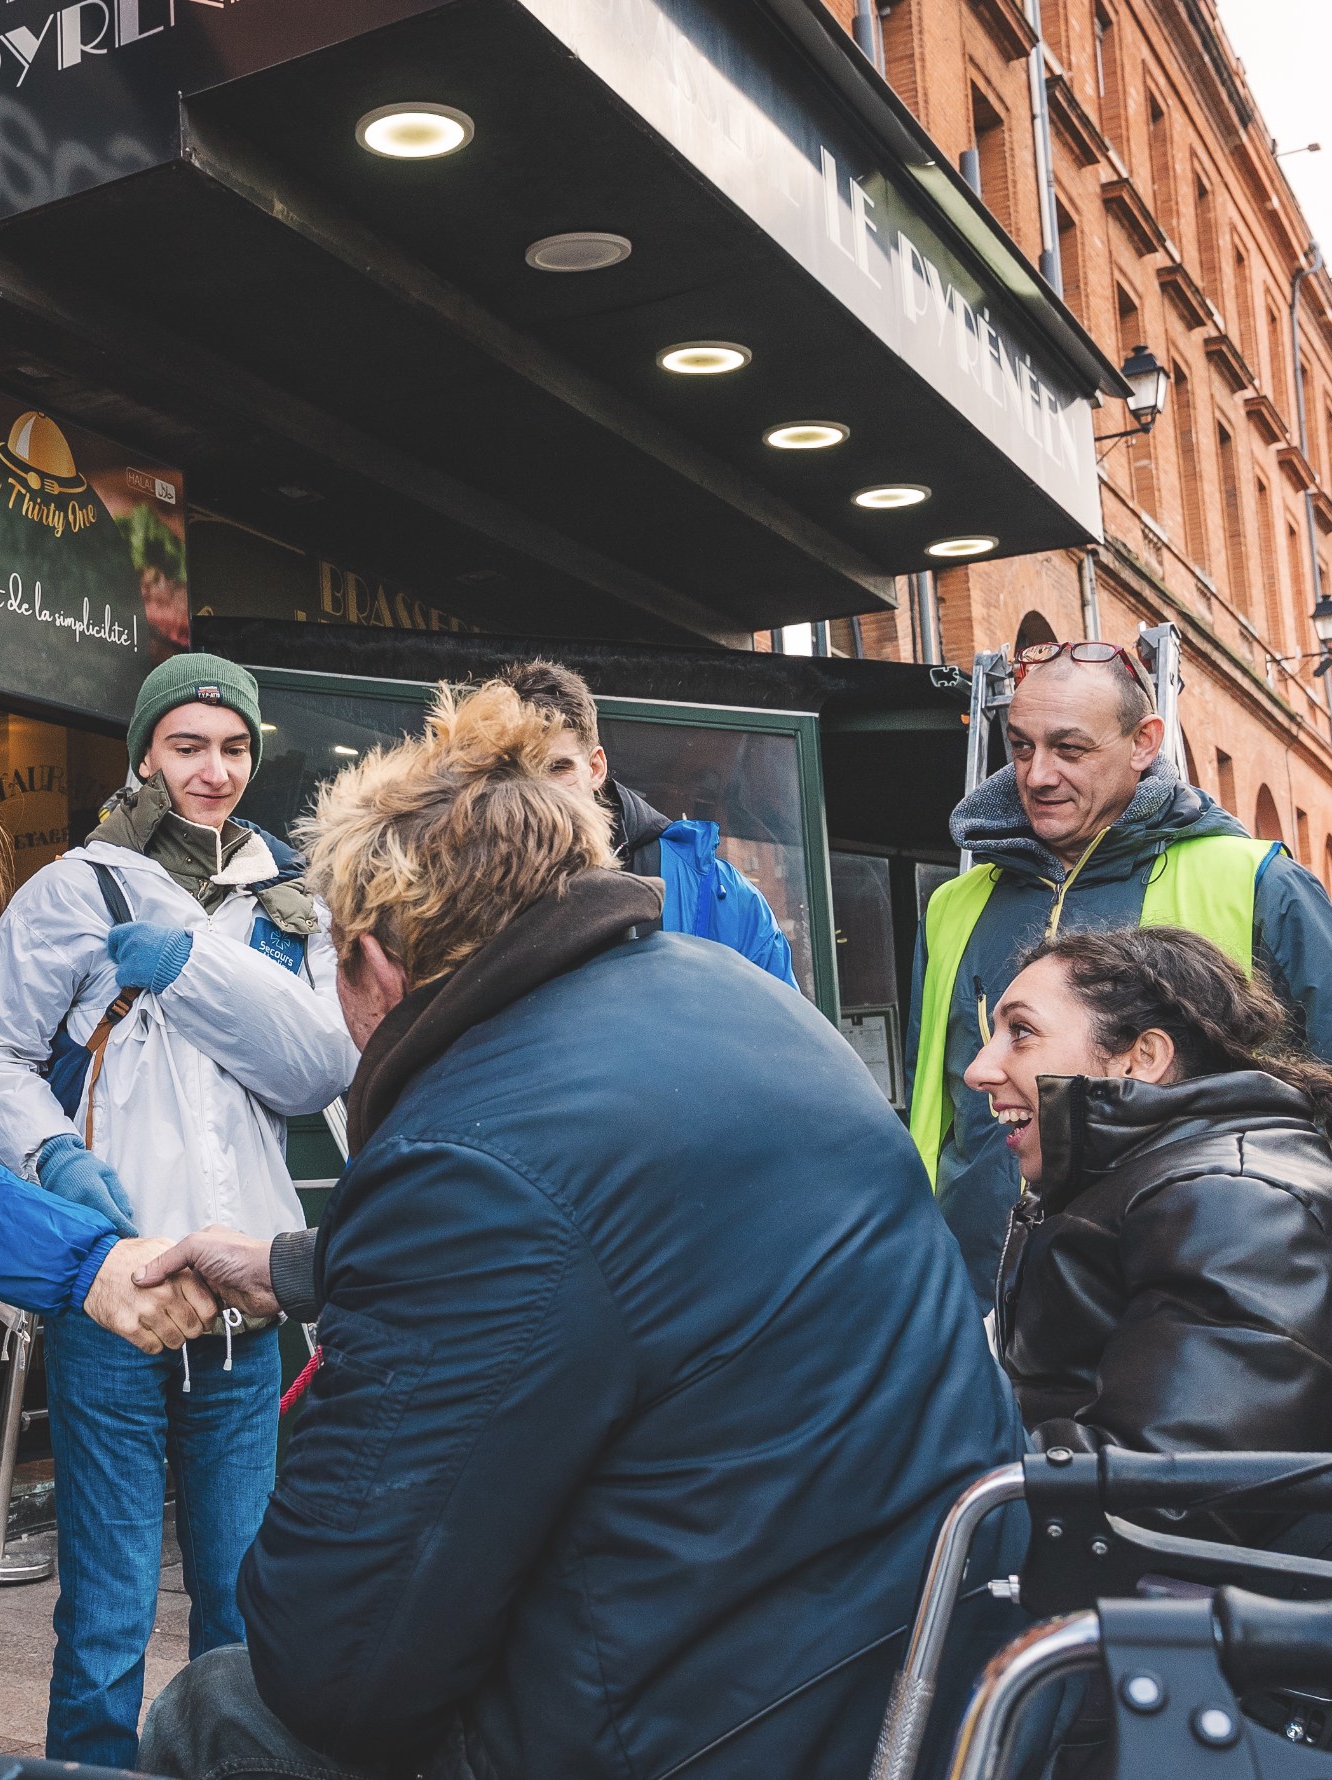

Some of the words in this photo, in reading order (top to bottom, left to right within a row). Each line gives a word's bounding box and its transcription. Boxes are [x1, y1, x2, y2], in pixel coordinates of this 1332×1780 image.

[820, 145, 882, 290] LE
[128, 472, 155, 492] HALAL
[8, 478, 66, 538] Thirty
[68, 500, 97, 532] One
[7, 572, 33, 616] de
[34, 581, 53, 622] la
[259, 940, 294, 967] Secours
